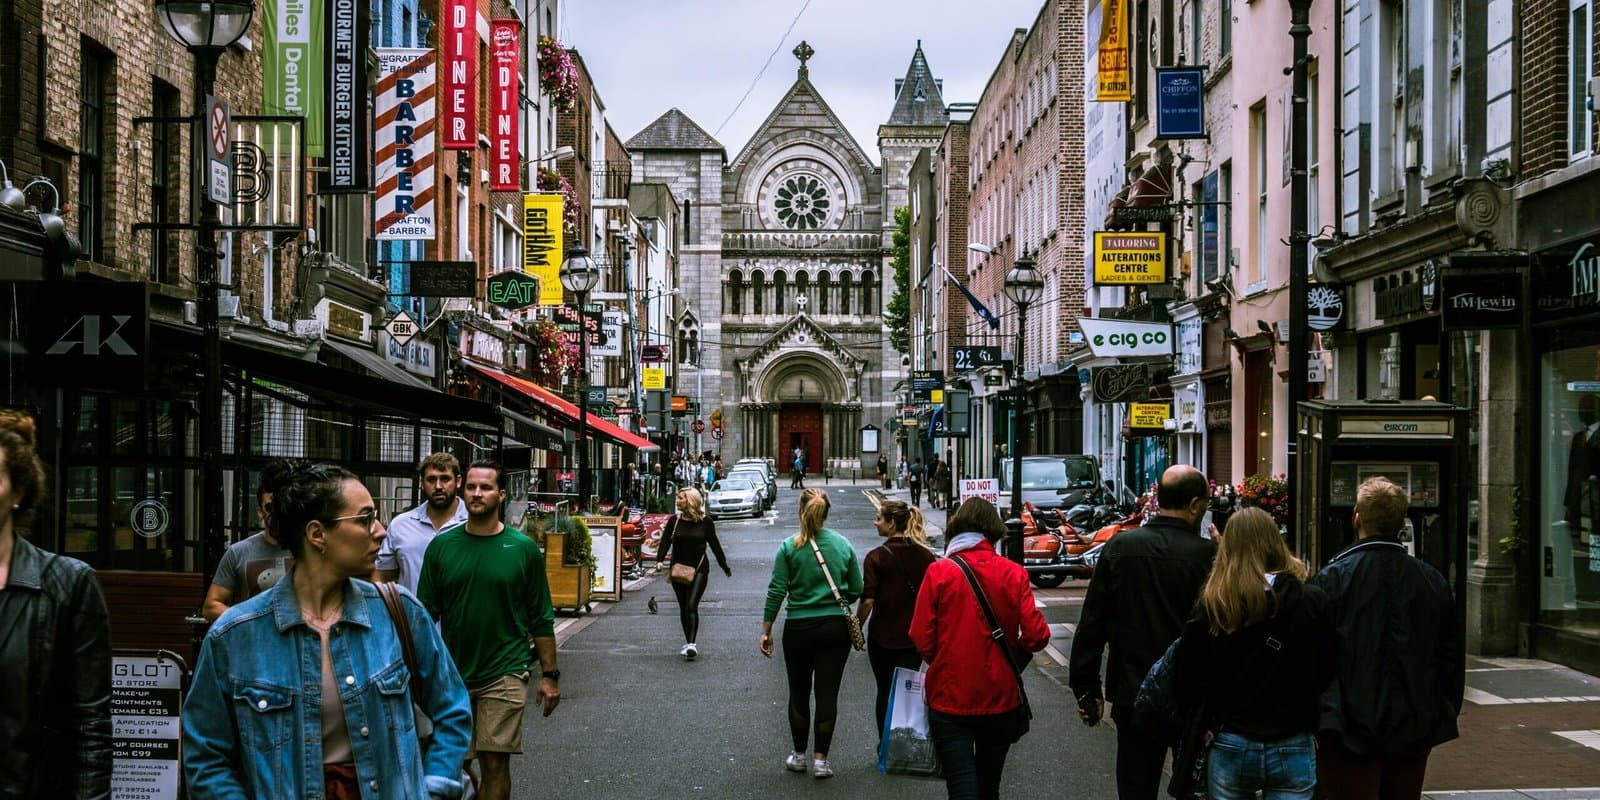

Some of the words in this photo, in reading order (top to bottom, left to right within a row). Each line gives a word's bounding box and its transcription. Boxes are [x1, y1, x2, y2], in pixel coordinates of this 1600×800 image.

[286, 0, 303, 36] iles
[389, 55, 432, 63] GRAFTON
[390, 66, 427, 74] BARBER
[452, 5, 467, 141] DINER
[284, 47, 303, 113] Dental
[335, 63, 352, 119] BURGER
[498, 67, 511, 184] DINER
[394, 79, 417, 215] BARBER
[335, 124, 351, 186] KITCHEN
[388, 217, 431, 225] GRAFTON
[389, 227, 427, 236] BARBER
[526, 208, 557, 266] GOTHAM
[1105, 239, 1157, 249] TAILORING
[1101, 252, 1162, 263] ALTERATIONS
[1114, 263, 1149, 273] CENTRE
[490, 279, 535, 303] EAT
[580, 304, 601, 312] INES
[45, 315, 138, 355] AK
[393, 323, 412, 333] GBK
[1093, 333, 1105, 346] e
[1109, 331, 1138, 349] cig
[1142, 332, 1167, 345] co
[966, 481, 976, 490] DO
[978, 480, 991, 490] NOT
[981, 493, 998, 502] THIS
[115, 664, 172, 678] GLOT
